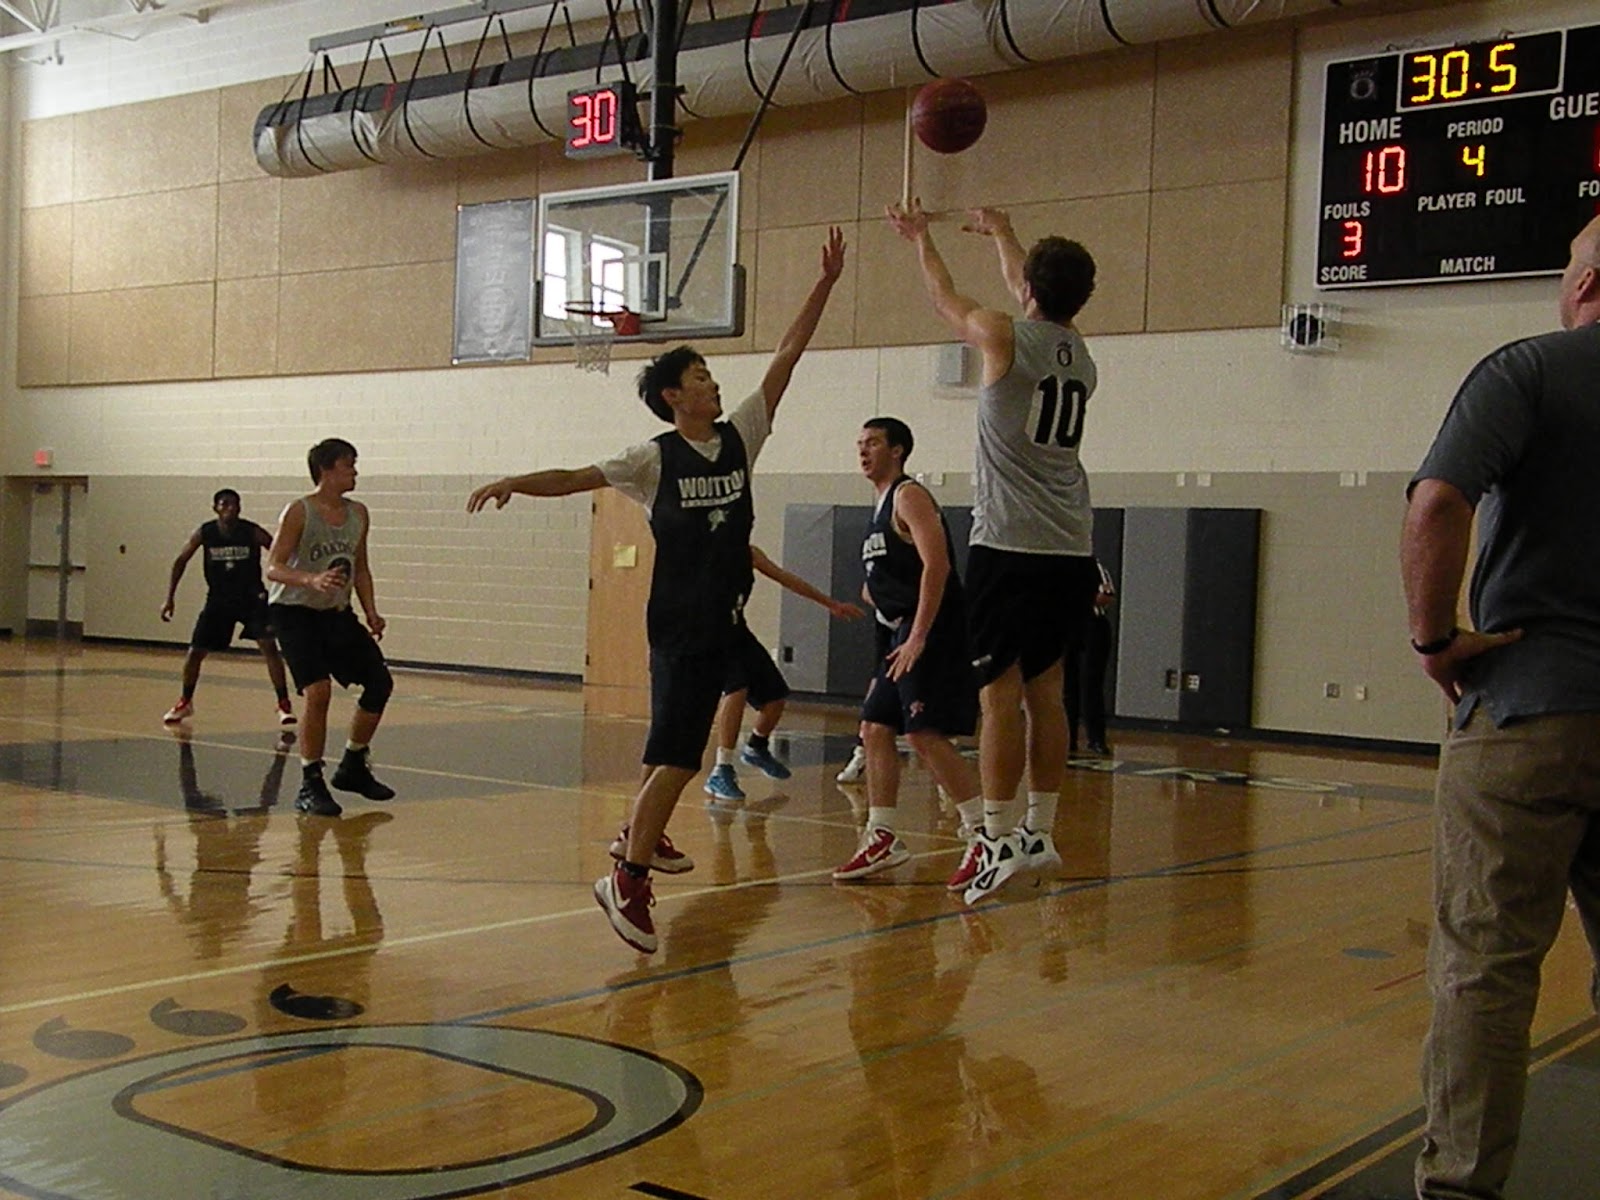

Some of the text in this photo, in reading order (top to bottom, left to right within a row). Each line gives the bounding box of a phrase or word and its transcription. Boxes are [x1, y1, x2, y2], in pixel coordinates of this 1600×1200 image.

[1411, 42, 1517, 102] 30.5
[571, 91, 616, 147] 30
[1339, 117, 1402, 144] HOME
[1447, 117, 1503, 139] PERIOD
[1364, 146, 1405, 193] 10
[1462, 145, 1485, 176] 4
[1324, 201, 1370, 220] FOULS
[1418, 188, 1526, 212] PLAYER FOUL
[1343, 221, 1362, 257] 3
[1320, 265, 1367, 282] SCORE
[1440, 256, 1495, 275] MATCH
[1034, 374, 1087, 448] 10
